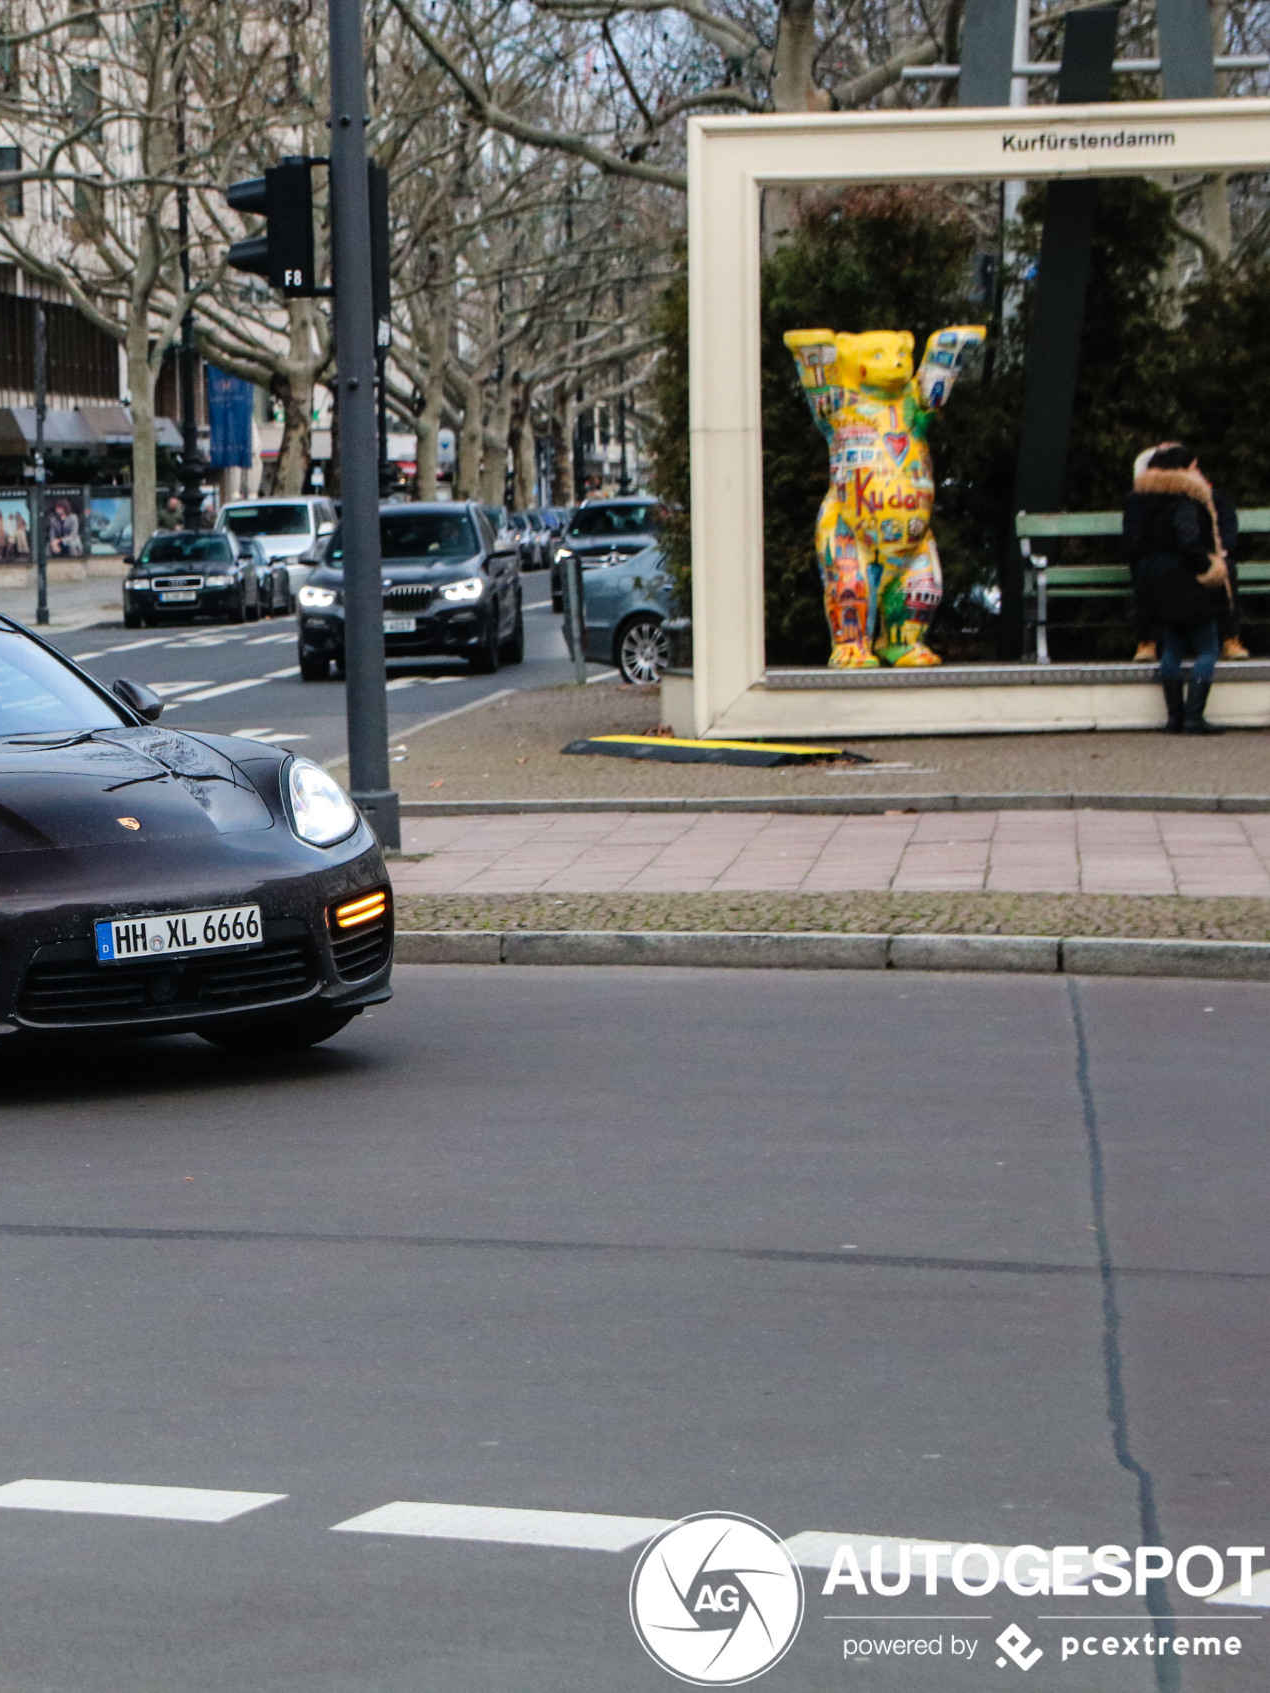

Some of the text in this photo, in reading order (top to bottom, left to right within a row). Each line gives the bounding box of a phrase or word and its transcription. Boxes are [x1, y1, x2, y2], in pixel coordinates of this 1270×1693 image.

[1002, 130, 1176, 153] Kurfürstendamm
[285, 269, 302, 286] F8
[115, 909, 260, 954] HH XL 6666
[102, 944, 110, 953] D
